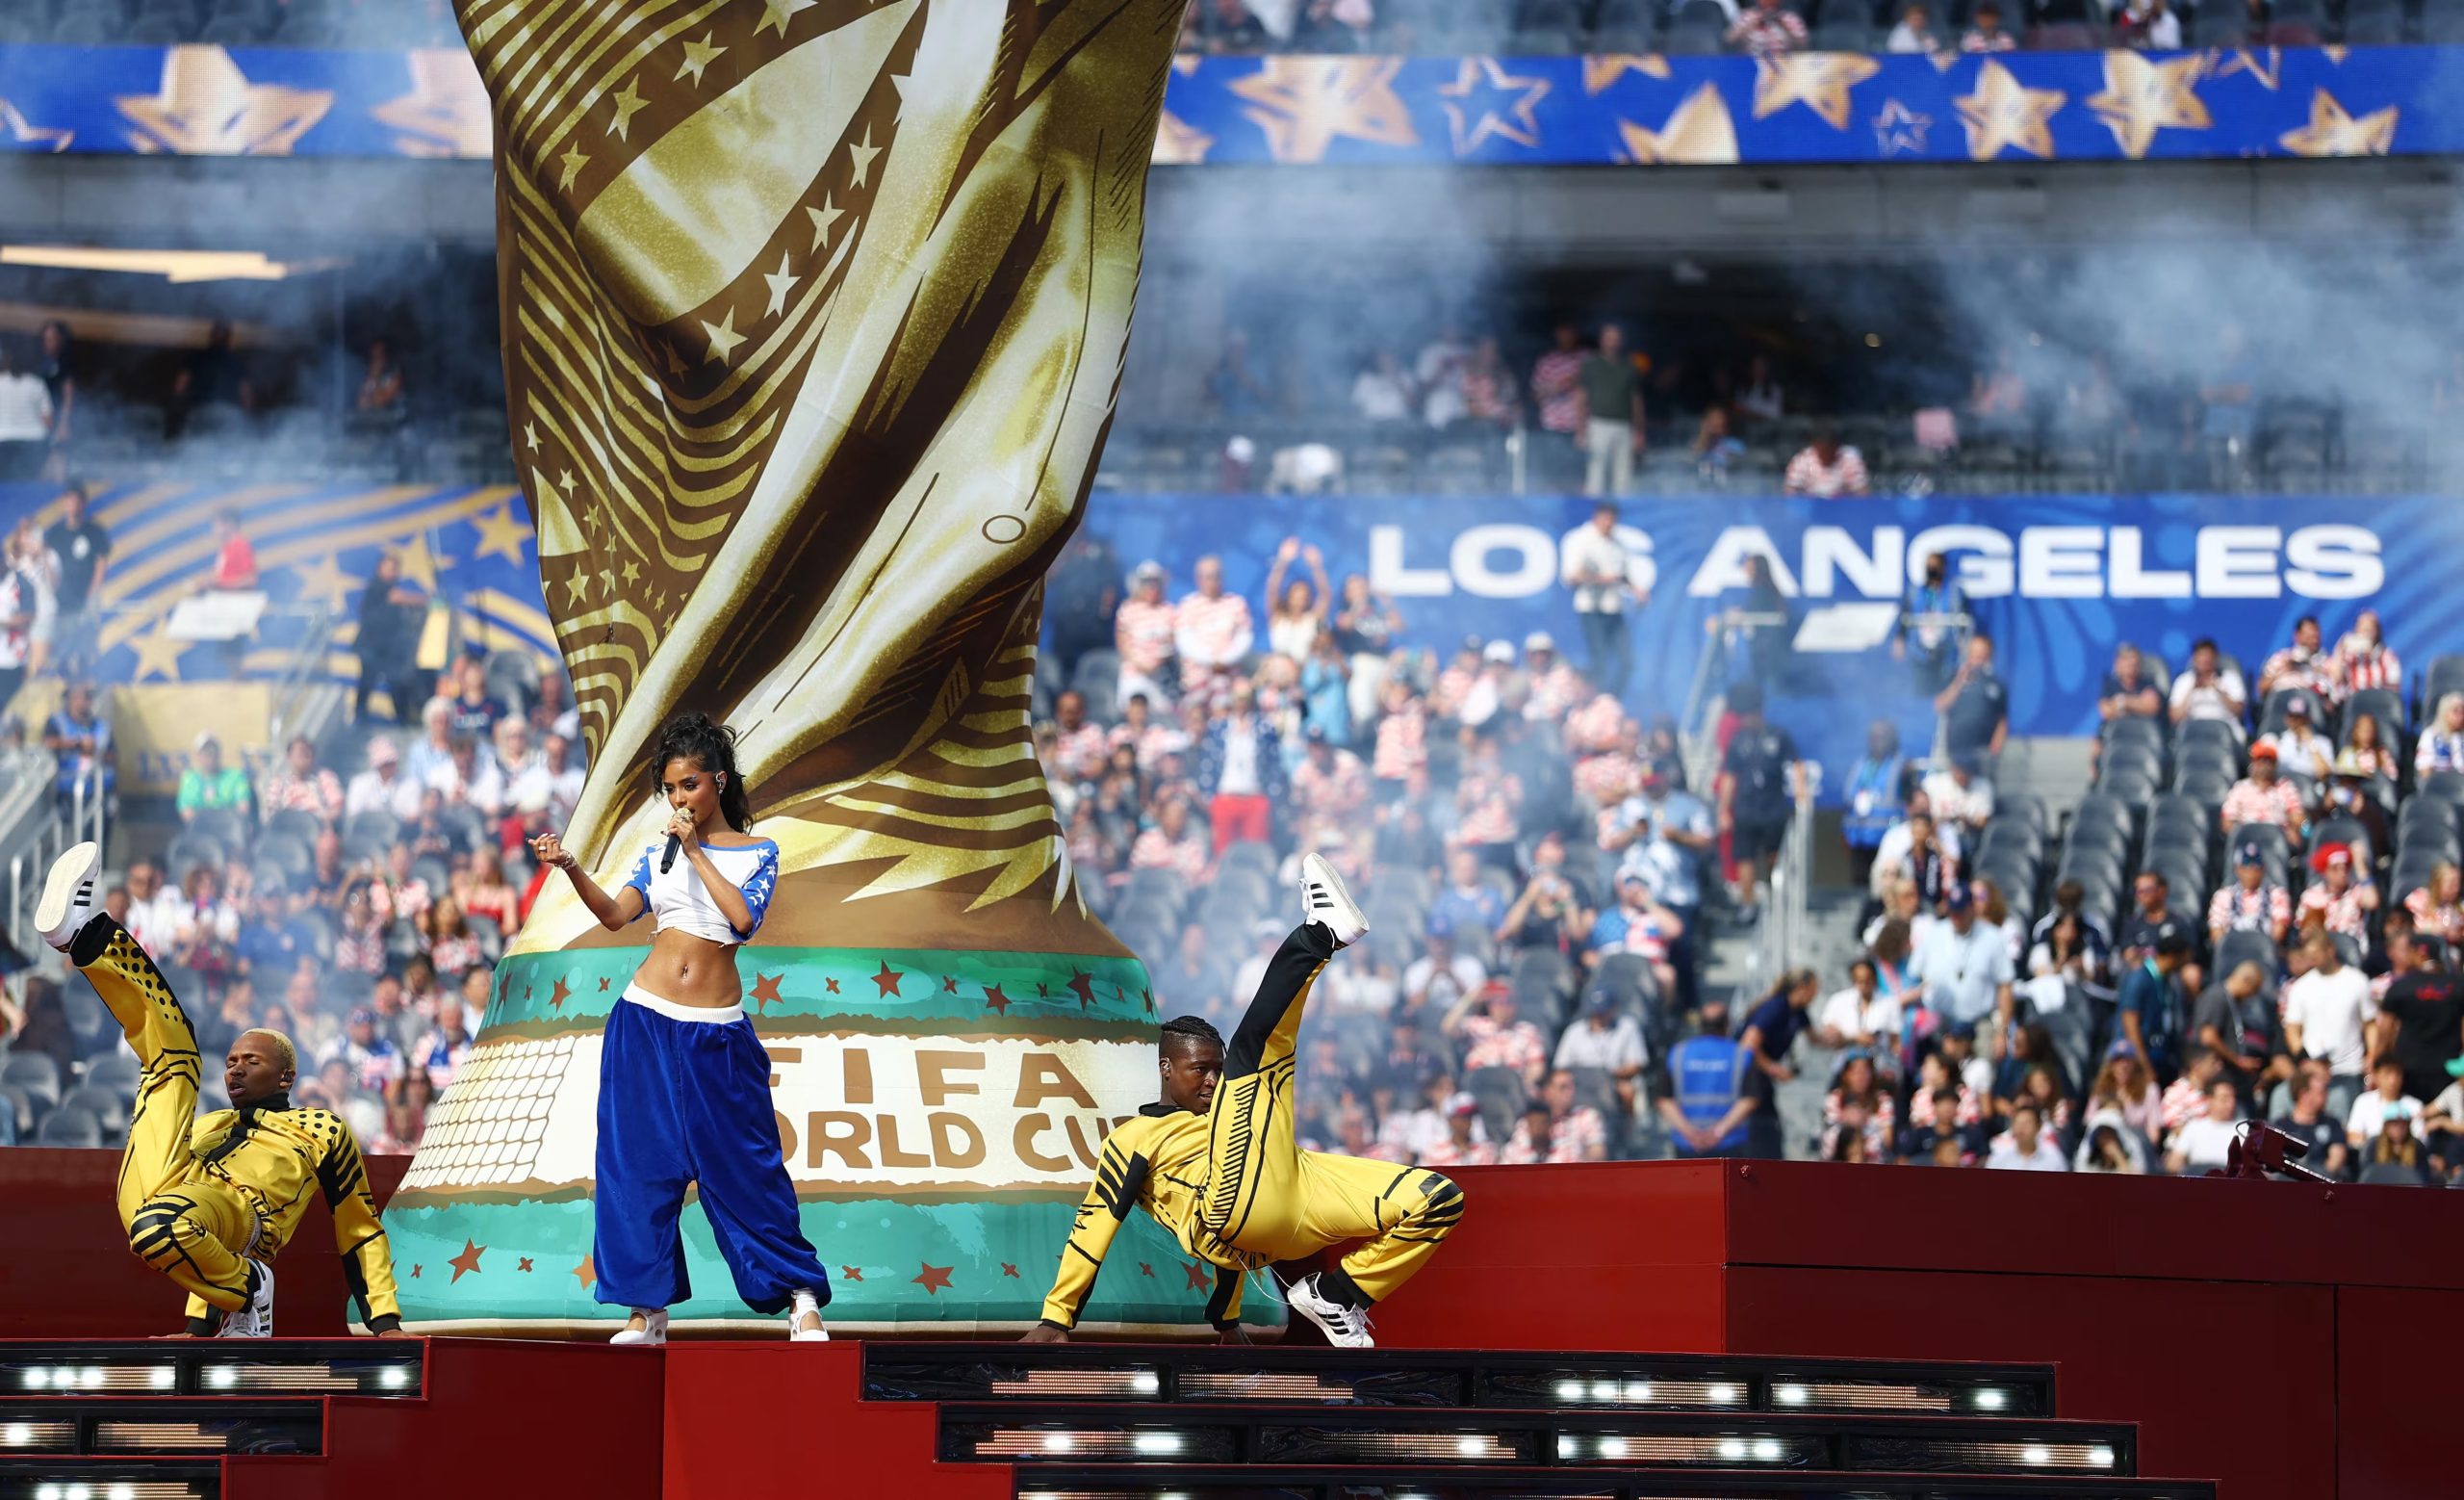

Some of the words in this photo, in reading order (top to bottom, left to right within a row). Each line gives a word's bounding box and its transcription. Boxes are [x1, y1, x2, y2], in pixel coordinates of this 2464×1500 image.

[1687, 524, 2385, 599] ANGELES
[774, 1109, 987, 1169] RLD
[1013, 1112, 1136, 1173] CU
